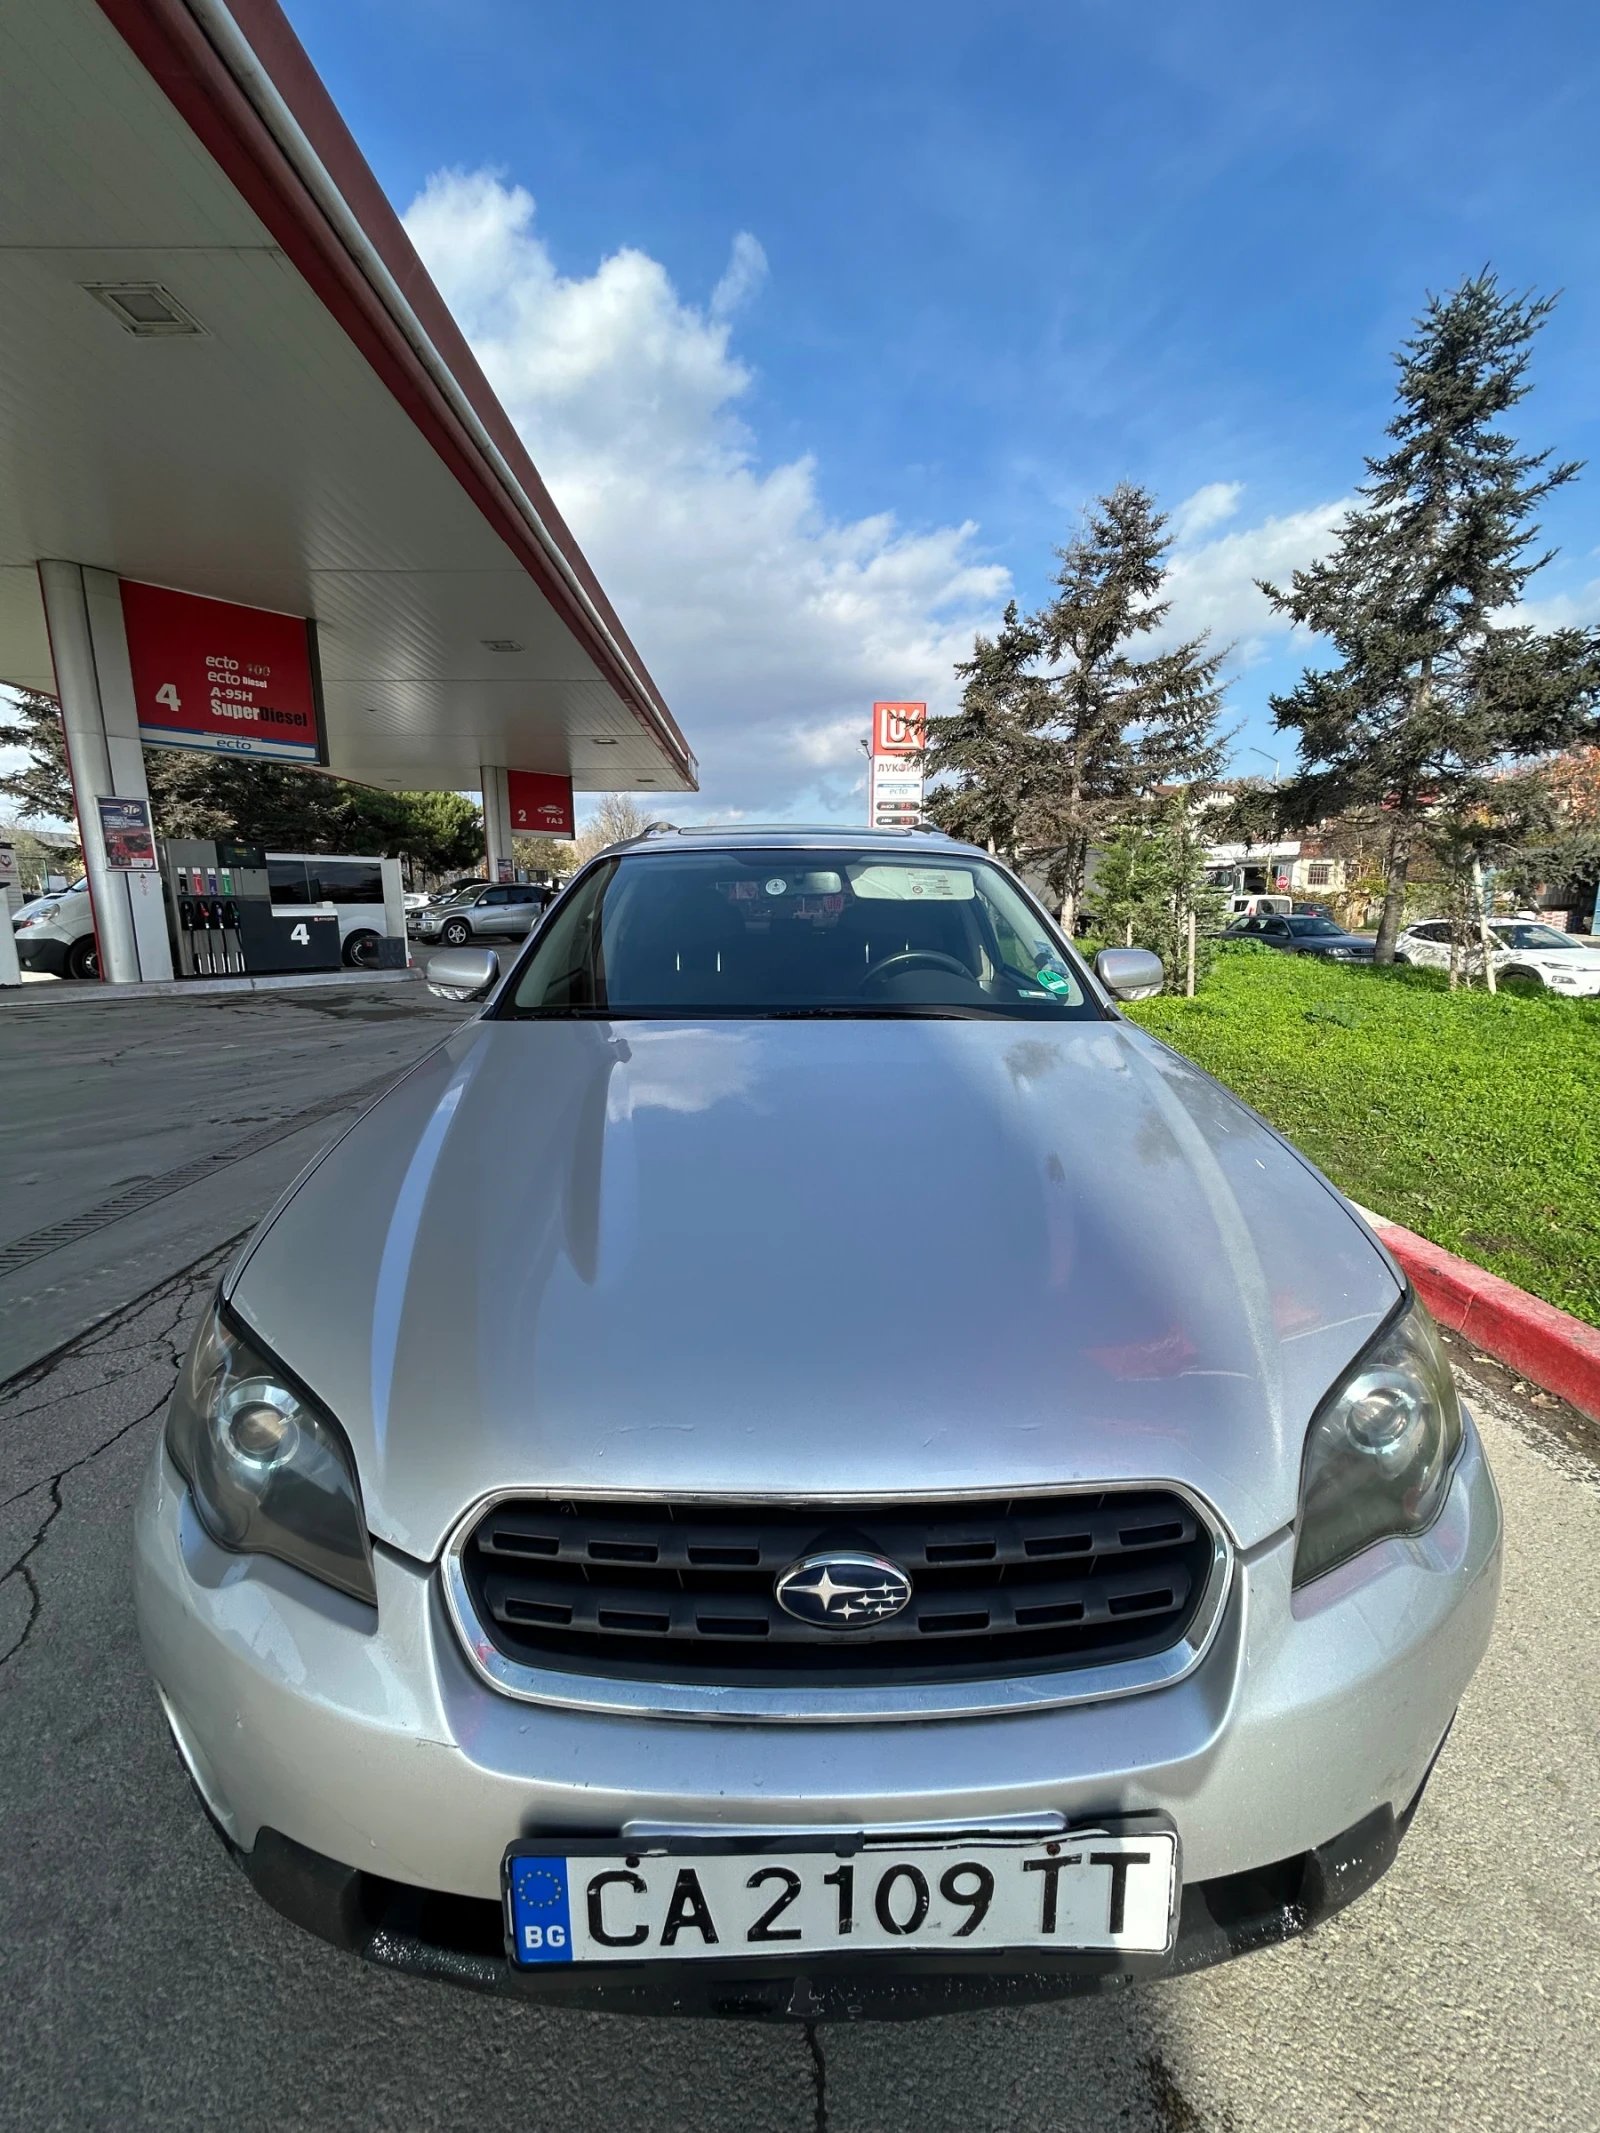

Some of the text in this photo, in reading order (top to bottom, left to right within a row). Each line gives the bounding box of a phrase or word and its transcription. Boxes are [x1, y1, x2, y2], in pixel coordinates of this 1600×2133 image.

[205, 655, 239, 671] ecto
[207, 671, 268, 688] ecto Diesel
[155, 683, 182, 712] 4
[210, 686, 253, 702] A-95H
[216, 739, 252, 751] ecto
[122, 804, 140, 815] STP
[518, 809, 527, 822] 2
[546, 816, 564, 825] ГАЗ
[290, 923, 310, 946] 4
[587, 1852, 1151, 1948] CA 2109 TT
[525, 1925, 566, 1949] BG
